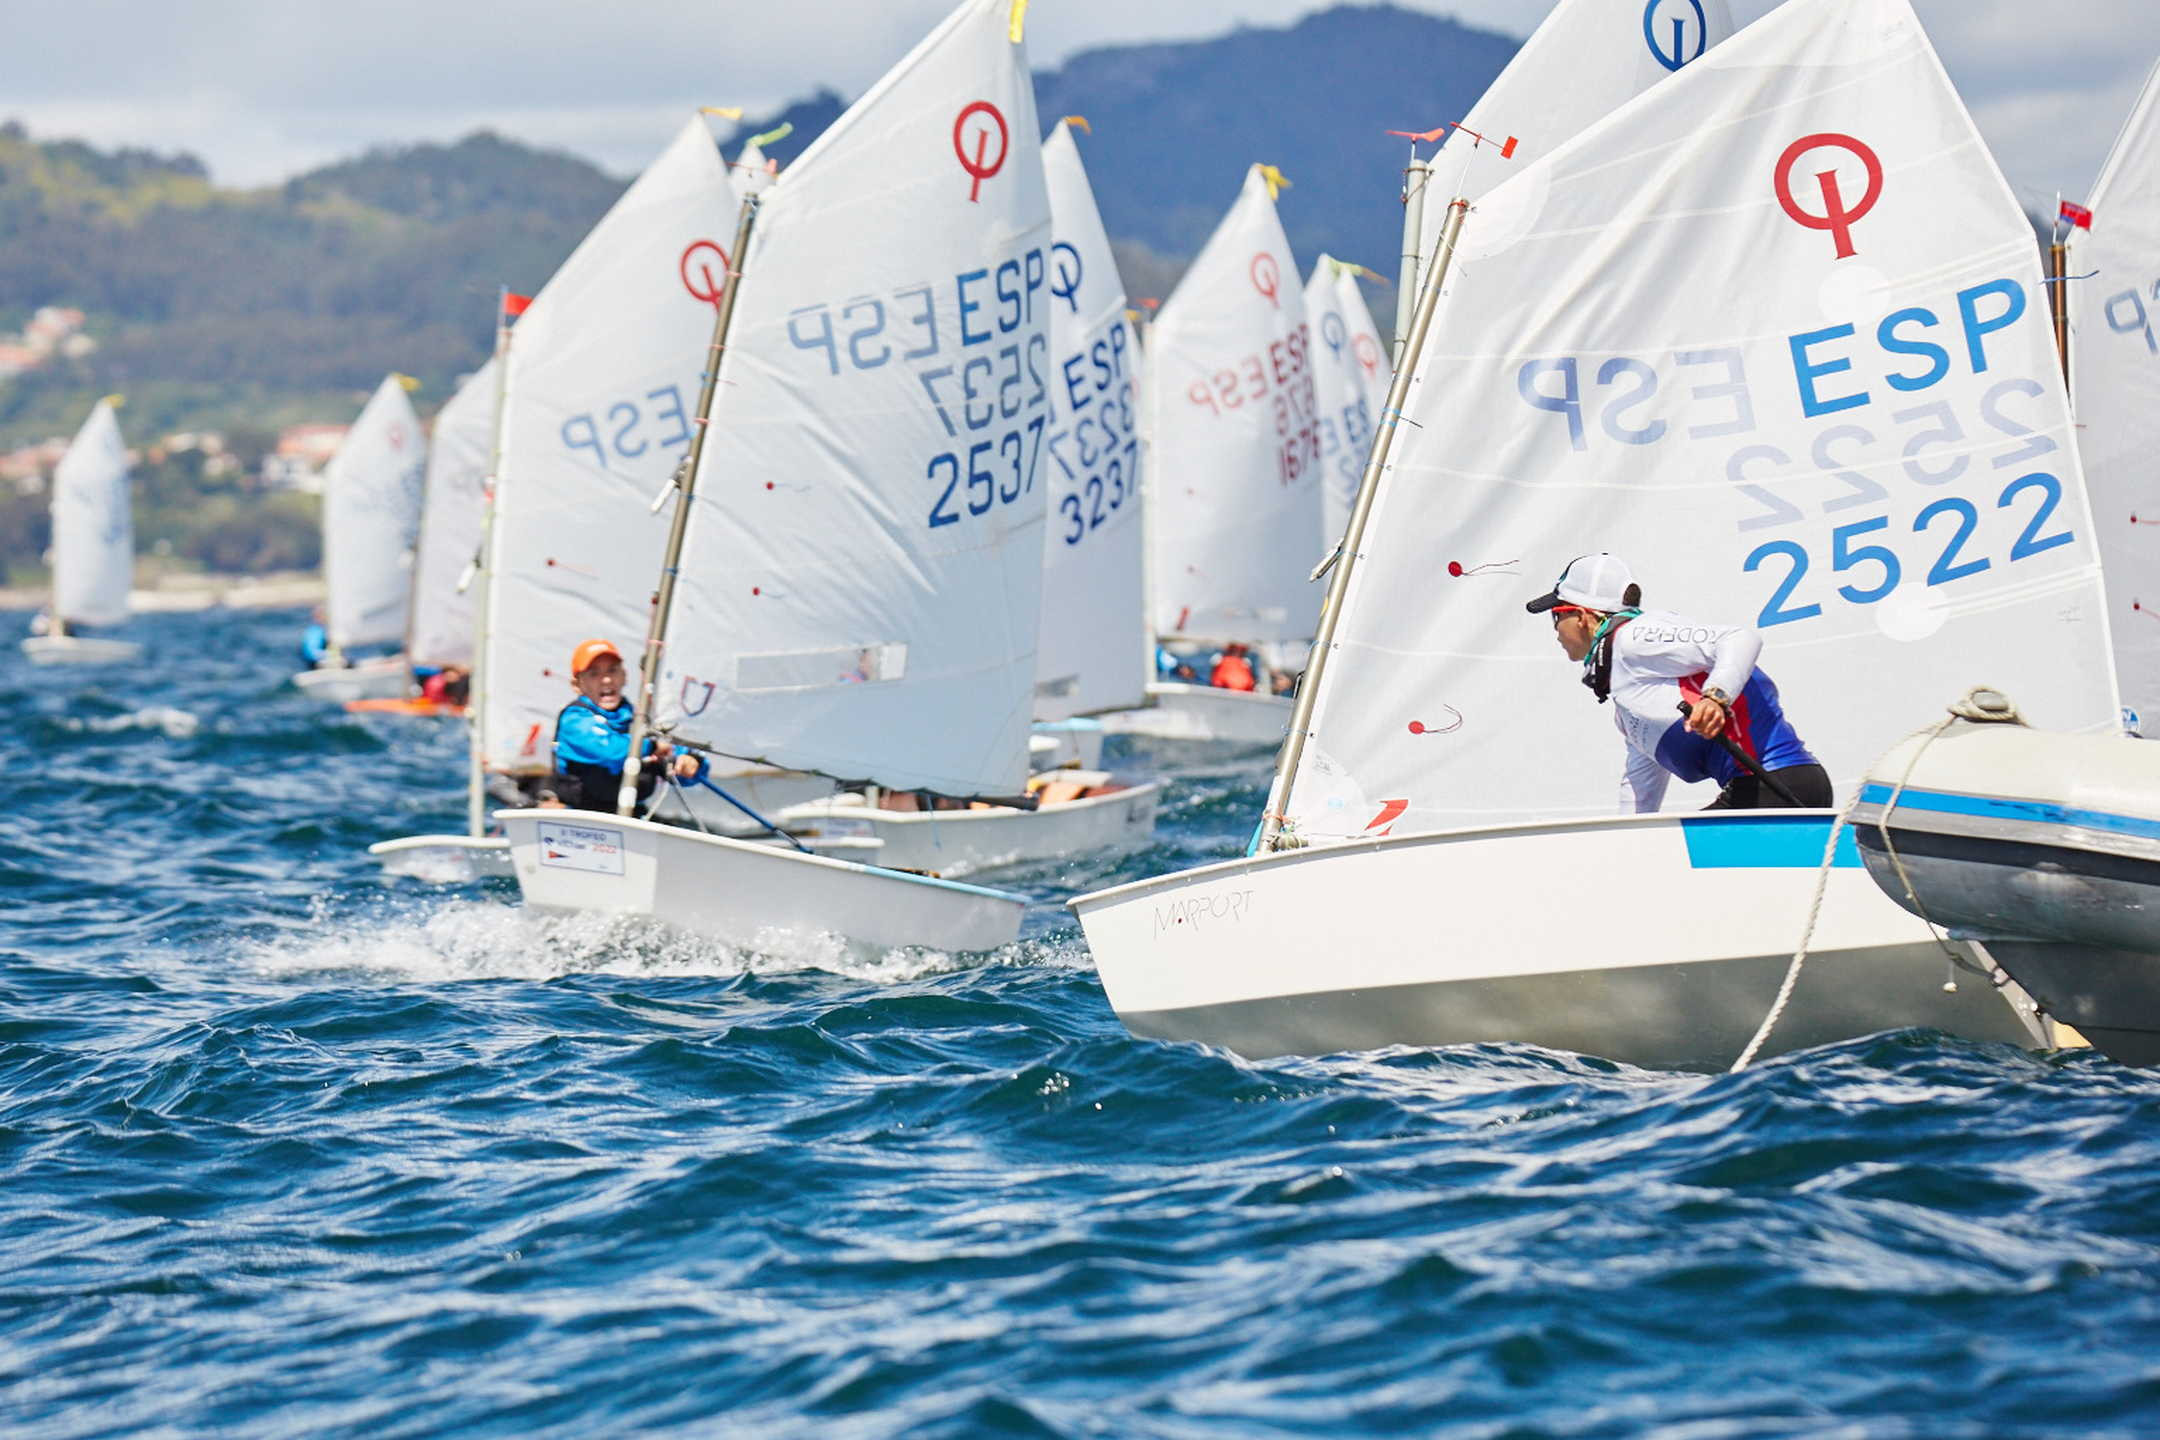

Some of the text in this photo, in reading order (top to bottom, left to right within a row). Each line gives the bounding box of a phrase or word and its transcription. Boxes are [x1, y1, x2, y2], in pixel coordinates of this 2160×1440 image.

[956, 248, 1044, 346] ESP
[1788, 277, 2027, 419] ESP
[1064, 322, 1126, 412] ESP
[928, 414, 1045, 528] 2537
[1060, 439, 1137, 545] 3237
[1742, 472, 2075, 629] 2522
[1153, 890, 1254, 940] MARPORT
